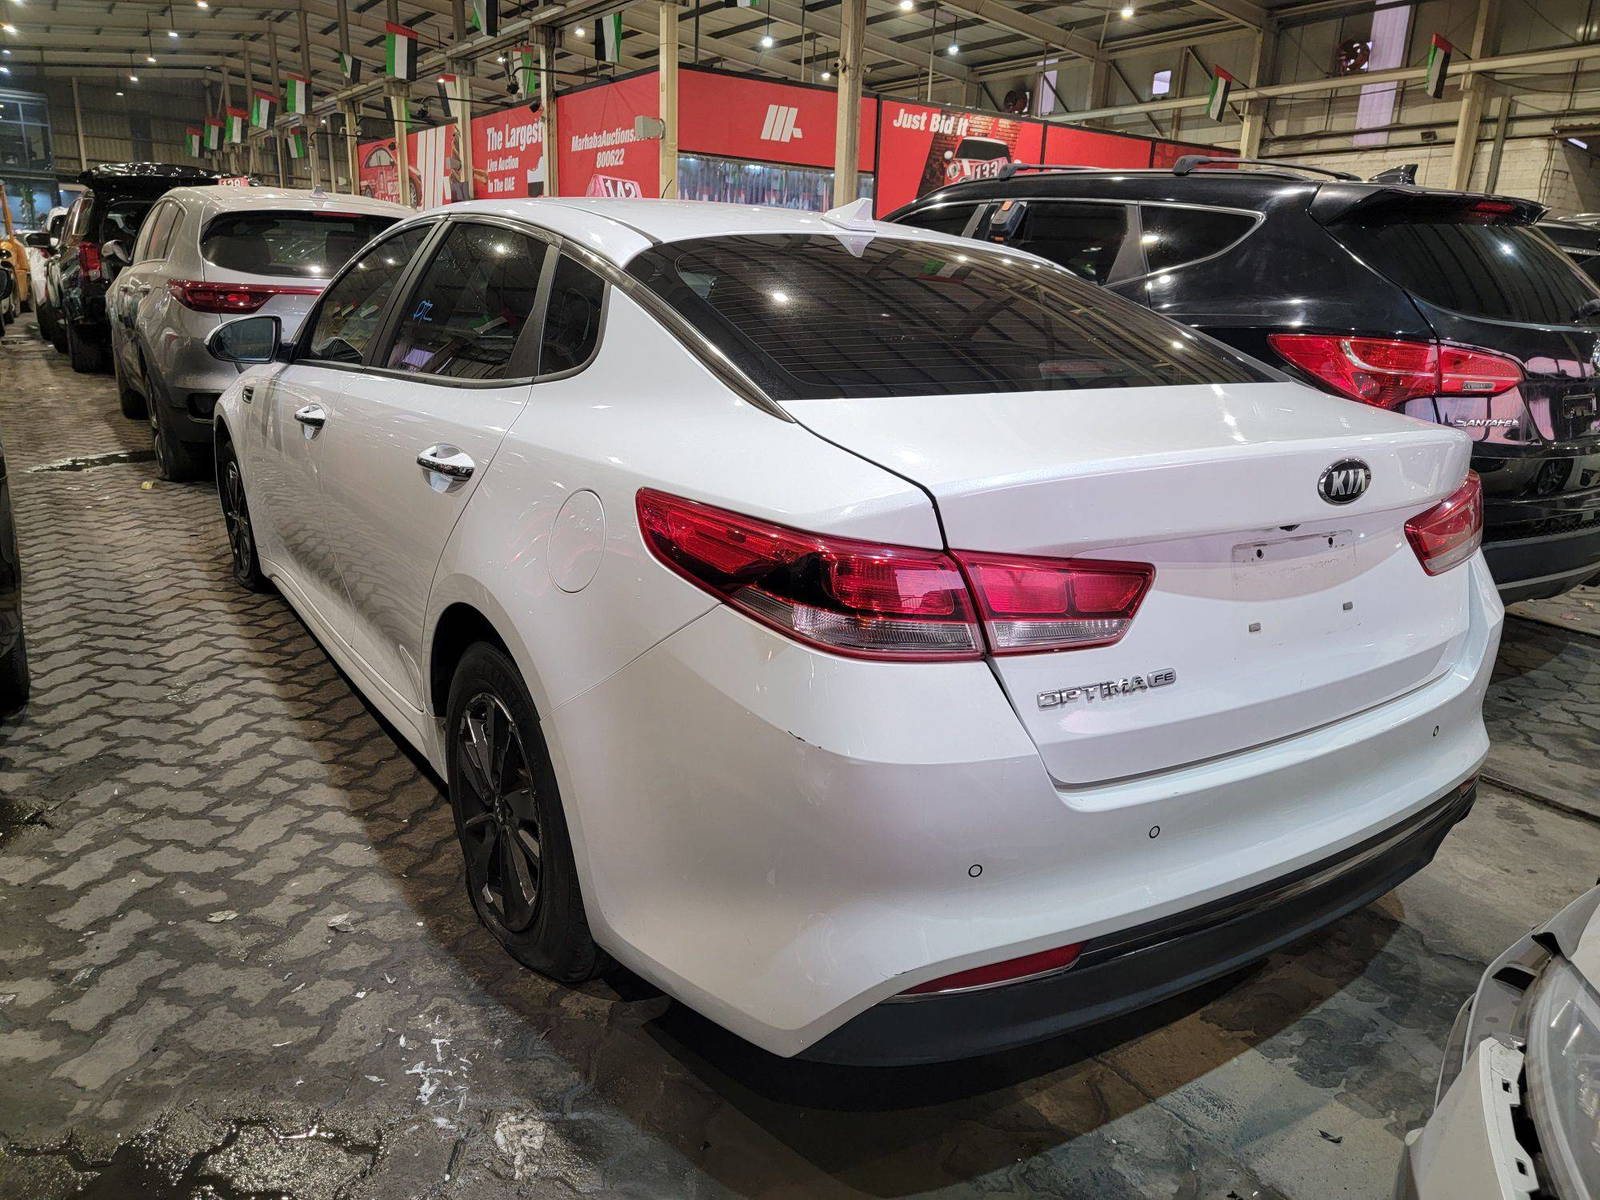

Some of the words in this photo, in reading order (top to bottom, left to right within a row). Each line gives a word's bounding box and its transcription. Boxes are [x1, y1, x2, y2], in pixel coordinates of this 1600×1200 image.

[893, 108, 927, 131] Just
[929, 113, 954, 135] Bid
[956, 114, 969, 136] It
[487, 127, 502, 151] The
[505, 119, 544, 152] Largest
[571, 127, 656, 152] MarhabaAuctions.
[488, 159, 498, 172] Live
[499, 155, 519, 170] Auction
[596, 148, 625, 169] 800622
[975, 161, 998, 179] 133
[494, 178, 503, 192] The
[504, 176, 515, 191] UAE
[1331, 468, 1366, 496] KIA
[1037, 676, 1149, 708] OPTIMA
